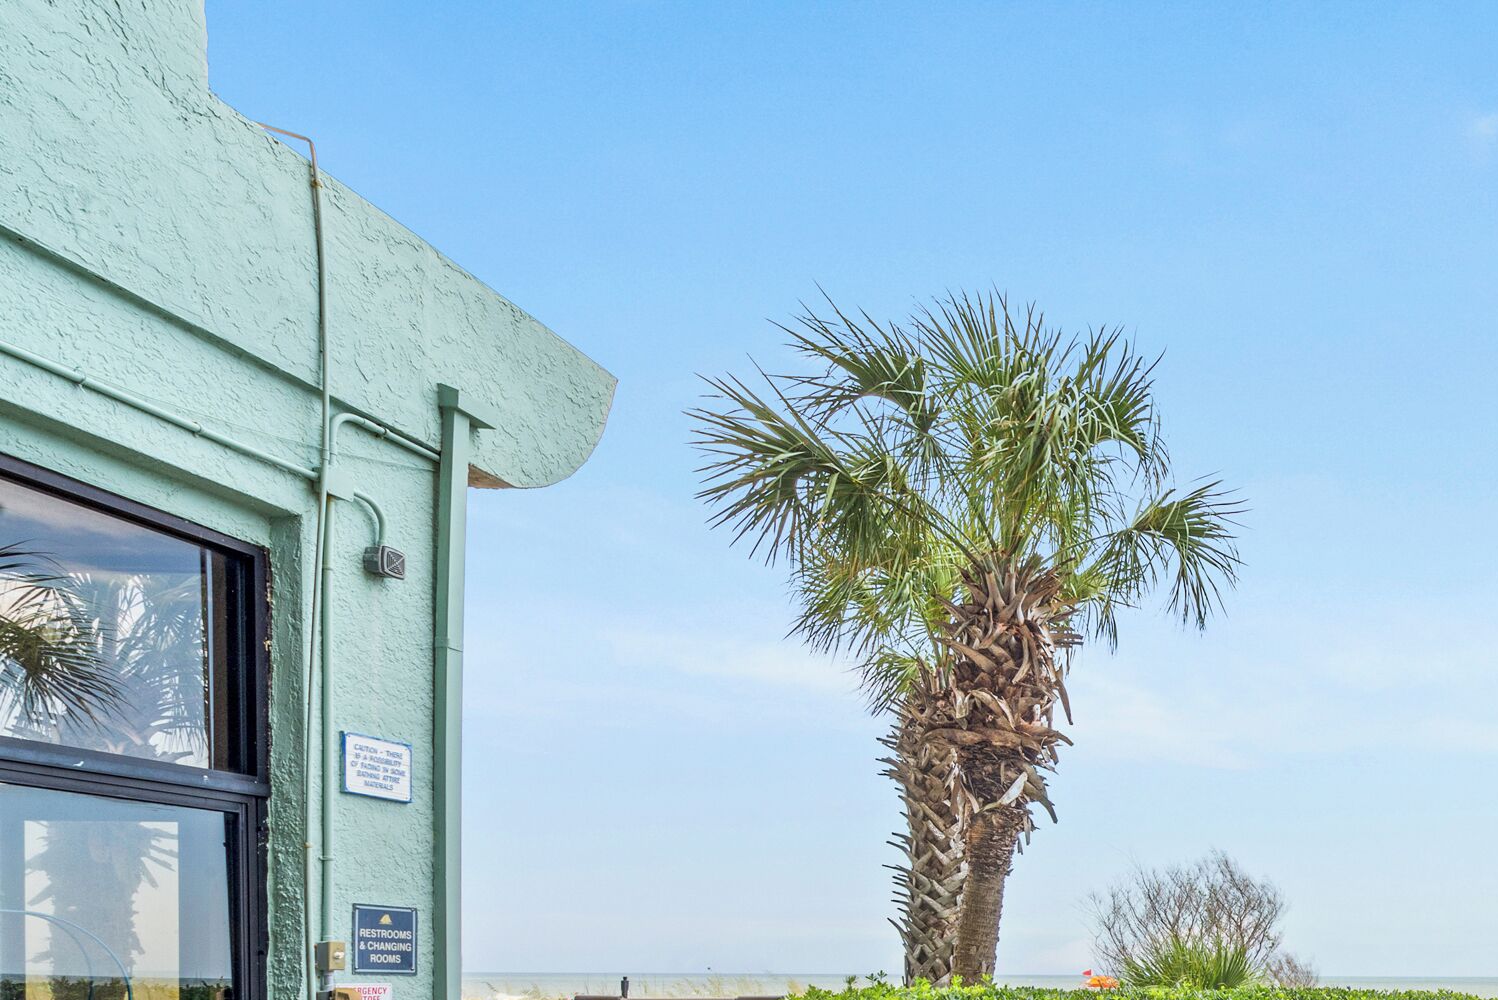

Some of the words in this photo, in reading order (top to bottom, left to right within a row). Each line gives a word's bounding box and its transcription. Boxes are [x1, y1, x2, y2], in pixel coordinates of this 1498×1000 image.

[360, 928, 412, 939] RESTROOMS
[359, 941, 366, 950] &
[367, 941, 412, 951] CHANGING
[370, 954, 401, 963] ROOMS
